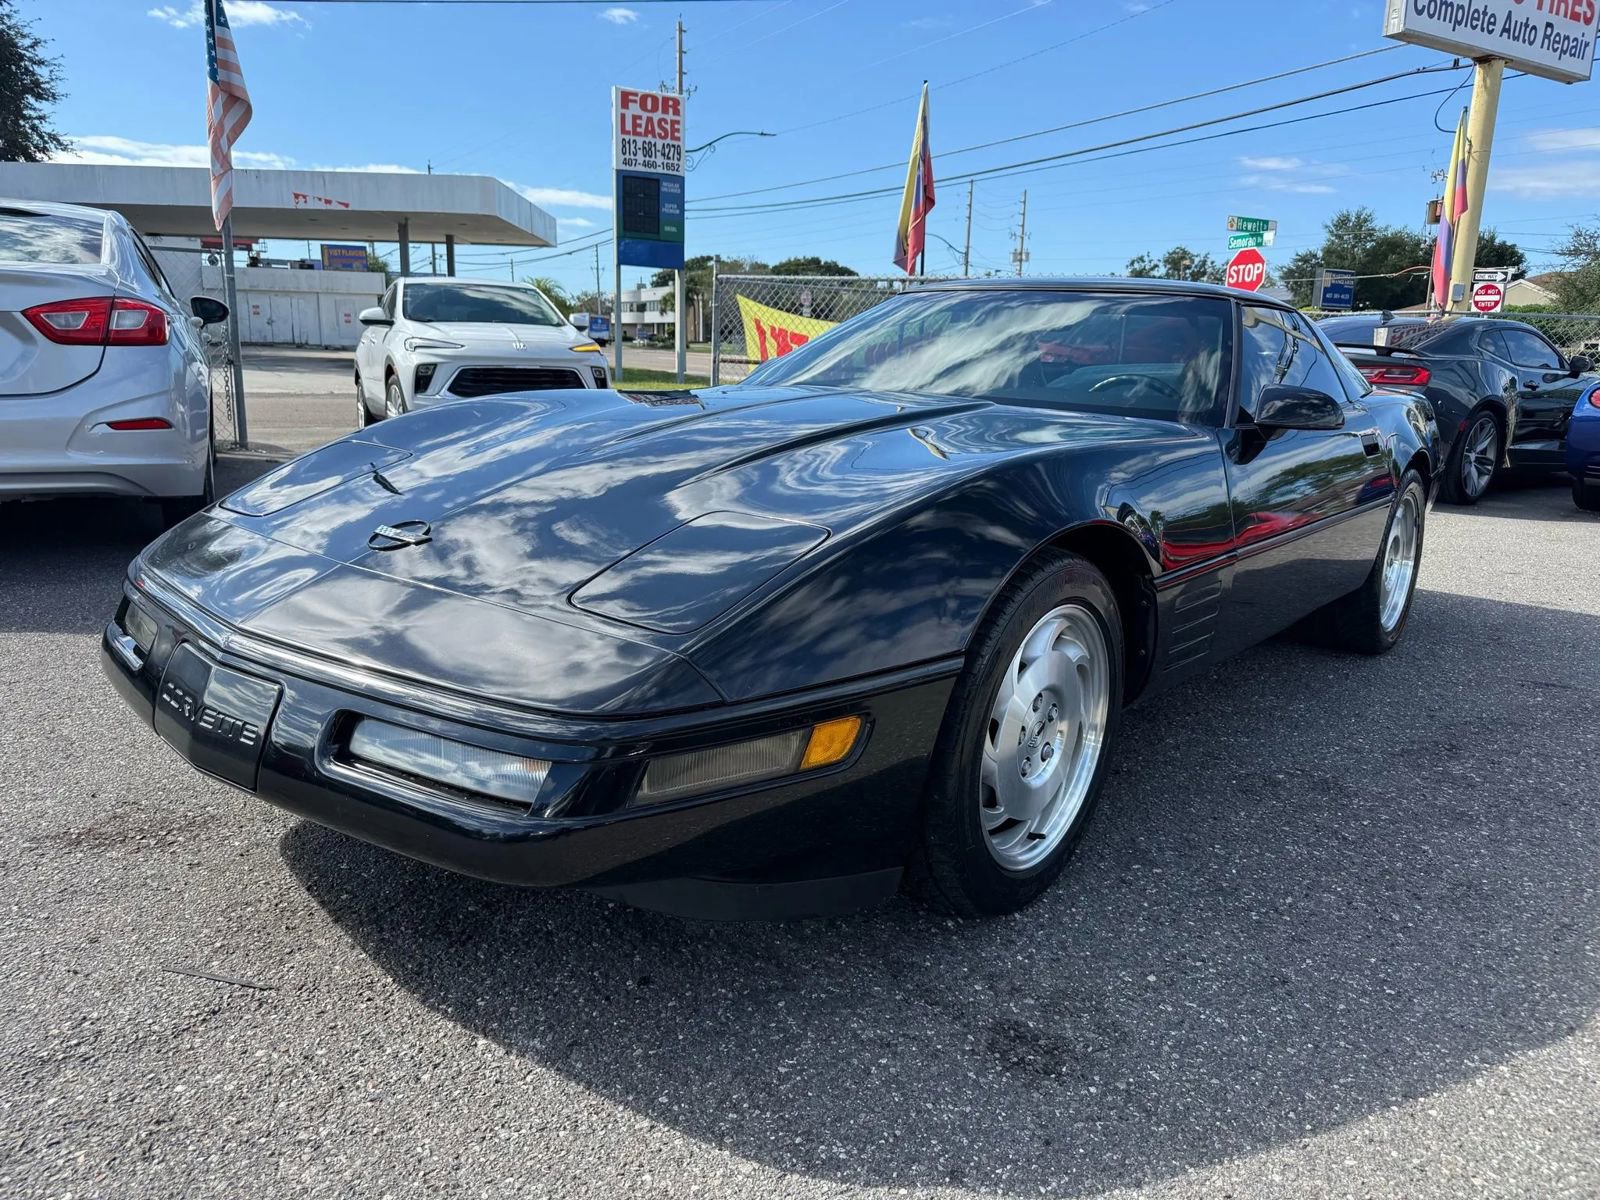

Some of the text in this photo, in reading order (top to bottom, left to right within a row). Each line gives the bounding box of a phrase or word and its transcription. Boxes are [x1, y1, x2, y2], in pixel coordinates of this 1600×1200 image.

[1413, 0, 1590, 61] Complete Auto Repair
[620, 90, 681, 116] FOR
[620, 112, 681, 142] LEASE
[621, 138, 682, 162] 813-681-4279
[622, 157, 681, 173] 407-460-1652
[1237, 218, 1263, 233] Hewett
[1229, 236, 1257, 248] Semoran
[1229, 263, 1263, 284] STOP
[162, 682, 259, 746] CORVETTE
